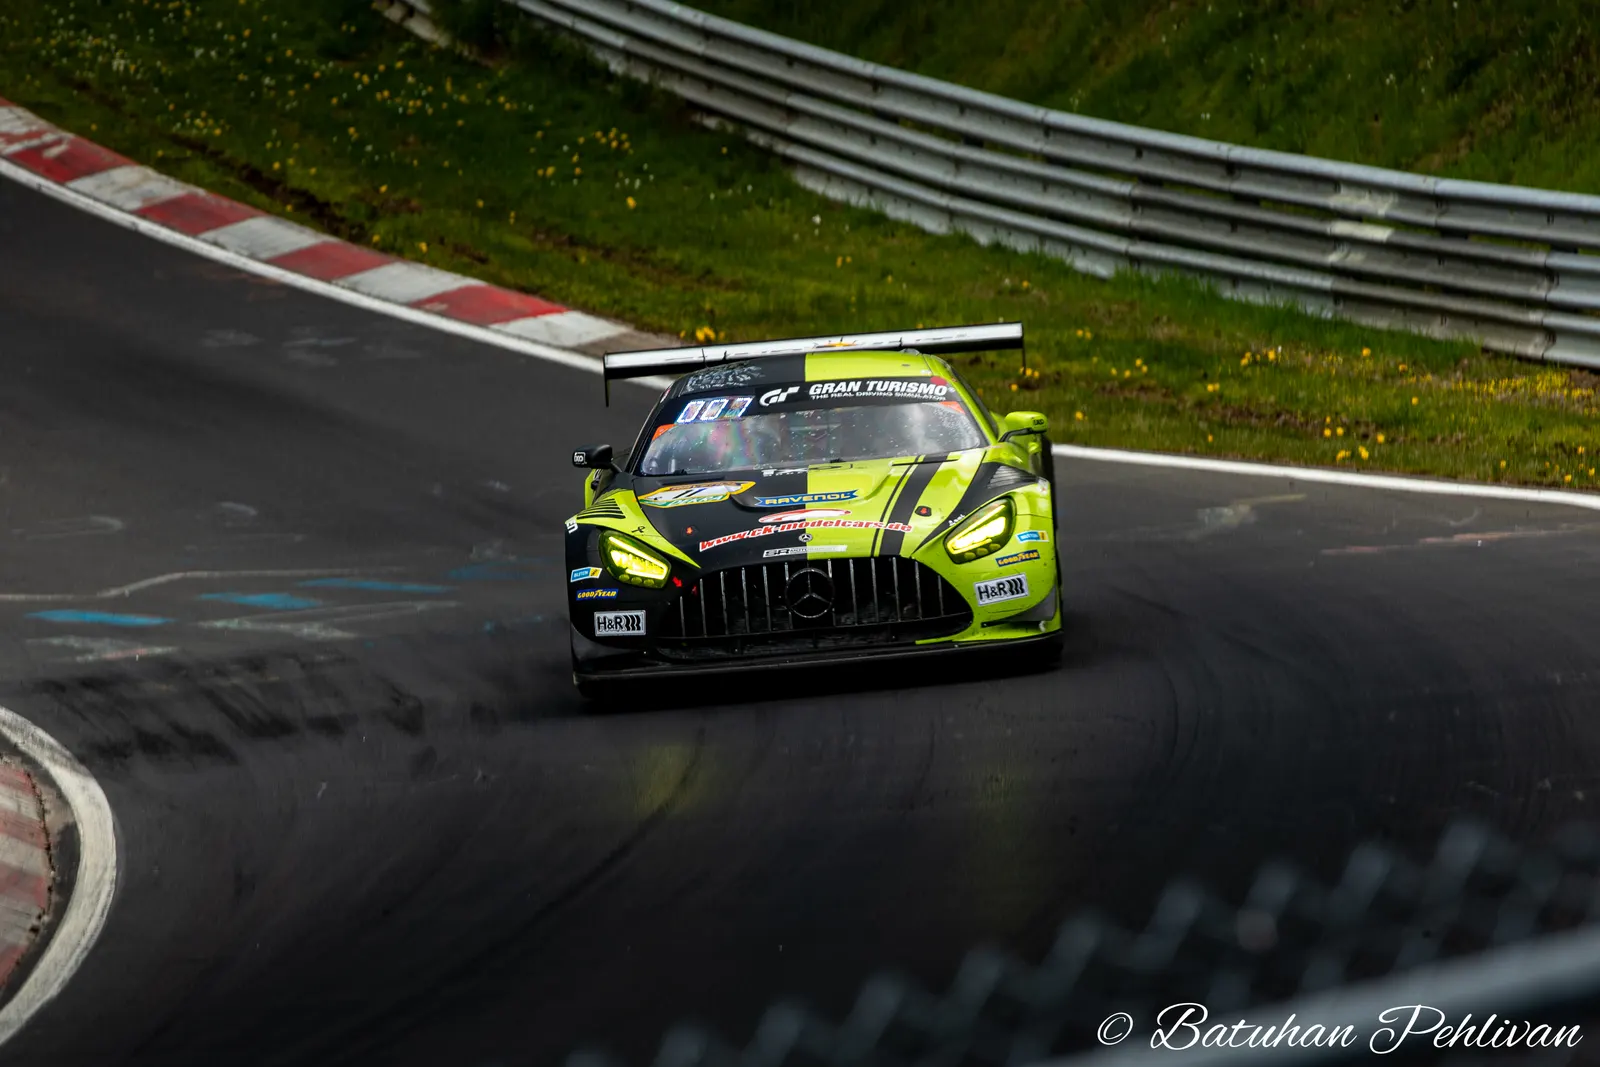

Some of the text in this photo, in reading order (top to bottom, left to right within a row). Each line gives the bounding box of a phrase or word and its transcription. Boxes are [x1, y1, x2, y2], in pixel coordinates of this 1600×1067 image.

[809, 380, 948, 396] GRAN TURISMO
[895, 393, 947, 401] SIMULATOR
[765, 493, 851, 505] RAVENOL
[699, 519, 913, 552] www.ck-modelcars.de
[997, 551, 1039, 566] GOODYEAR
[577, 589, 617, 599] GOODYEAR
[977, 581, 1008, 601] H&R
[596, 614, 624, 631] H&R
